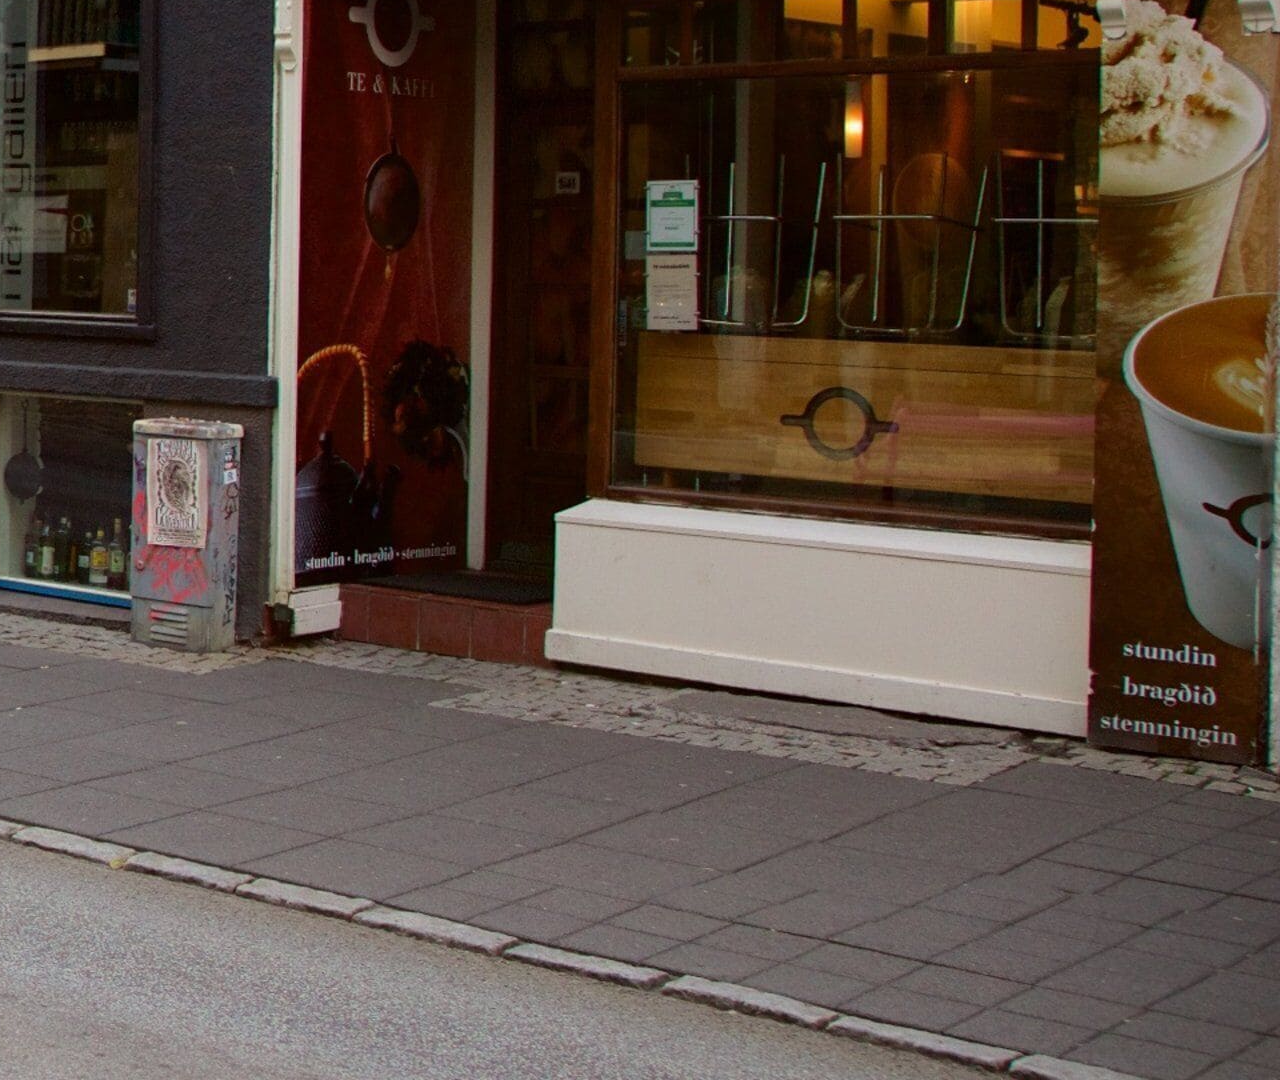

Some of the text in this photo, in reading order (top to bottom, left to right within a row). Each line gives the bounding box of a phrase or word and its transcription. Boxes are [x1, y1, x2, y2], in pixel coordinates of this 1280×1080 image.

[346, 71, 366, 92] TE
[372, 73, 385, 94] &
[305, 551, 345, 570] stundin
[1122, 640, 1217, 667] stundin
[1122, 675, 1217, 707] bragðið
[1099, 714, 1238, 748] stemningin
